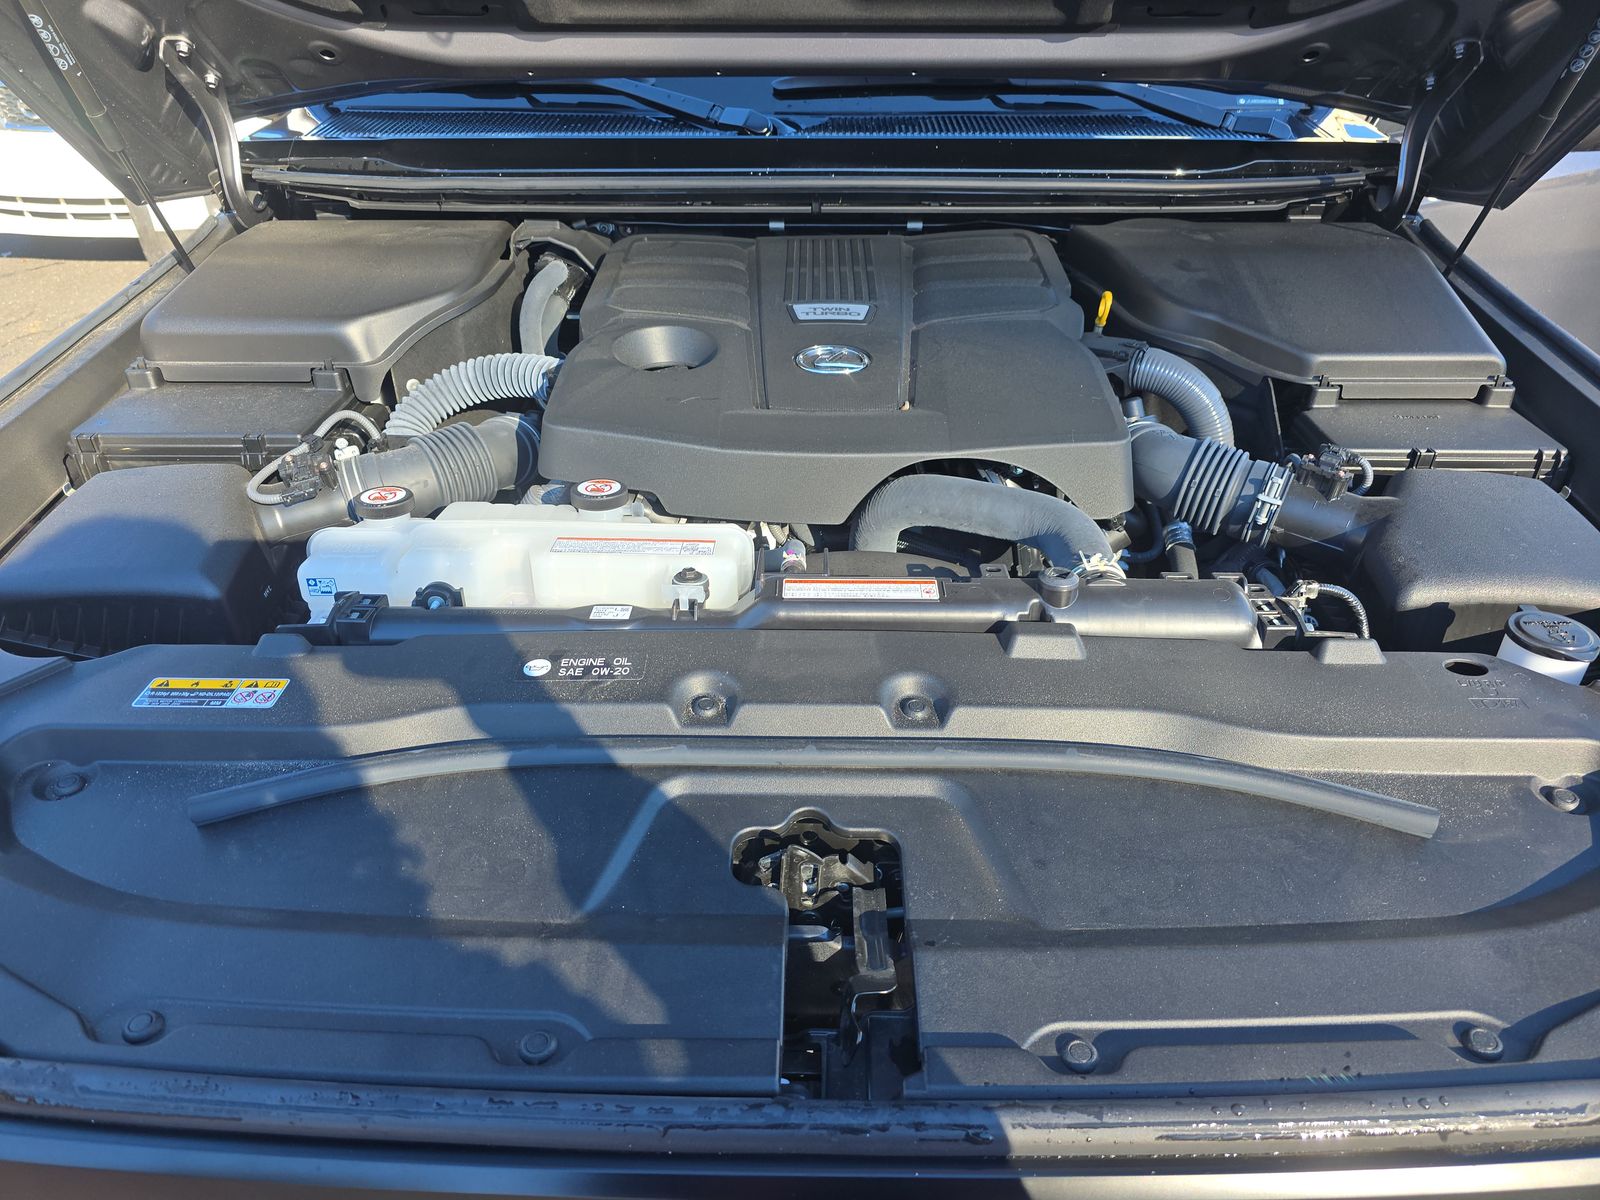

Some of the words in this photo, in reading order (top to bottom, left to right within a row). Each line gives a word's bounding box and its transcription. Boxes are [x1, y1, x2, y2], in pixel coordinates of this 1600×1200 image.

[560, 657, 606, 667] ENGINE
[613, 657, 633, 666] OIL
[558, 667, 584, 676] SAE
[591, 667, 630, 676] 0W-20
